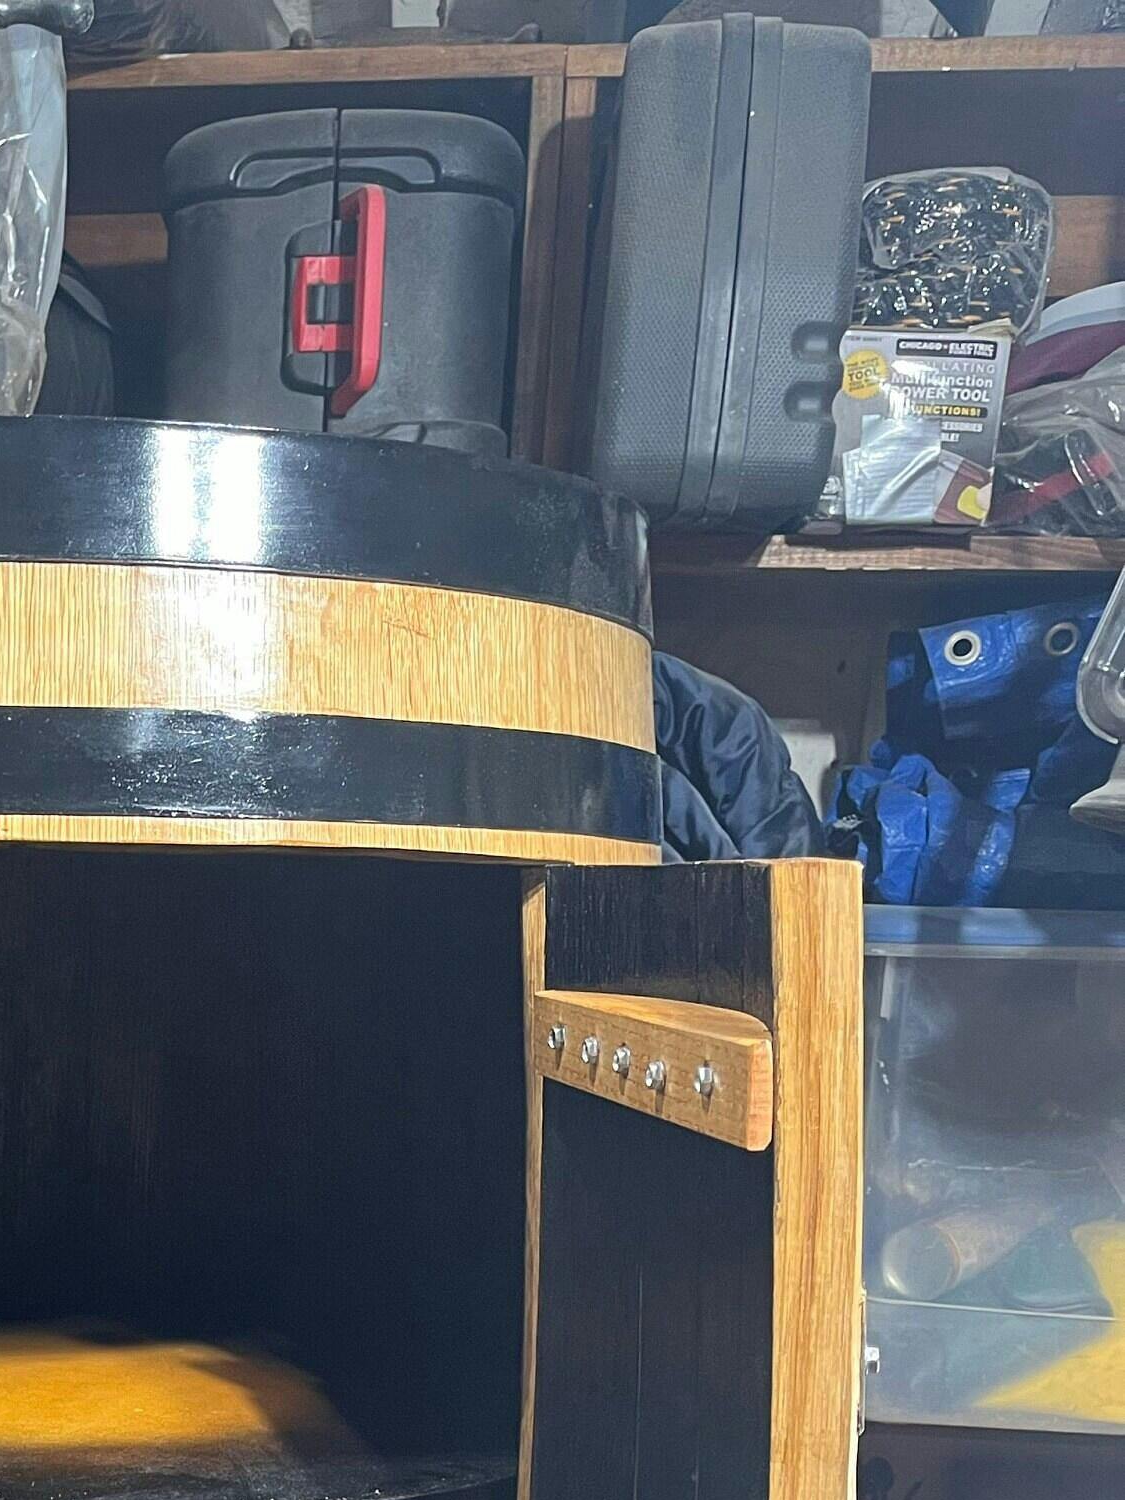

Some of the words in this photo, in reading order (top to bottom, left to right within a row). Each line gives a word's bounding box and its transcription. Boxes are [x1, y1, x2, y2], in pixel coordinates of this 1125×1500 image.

[898, 341, 943, 351] CHICAGO
[949, 342, 995, 352] ELECTRIC
[847, 367, 880, 381] TOOL
[951, 387, 991, 403] TOOL
[911, 404, 981, 417] UNCTIONS!
